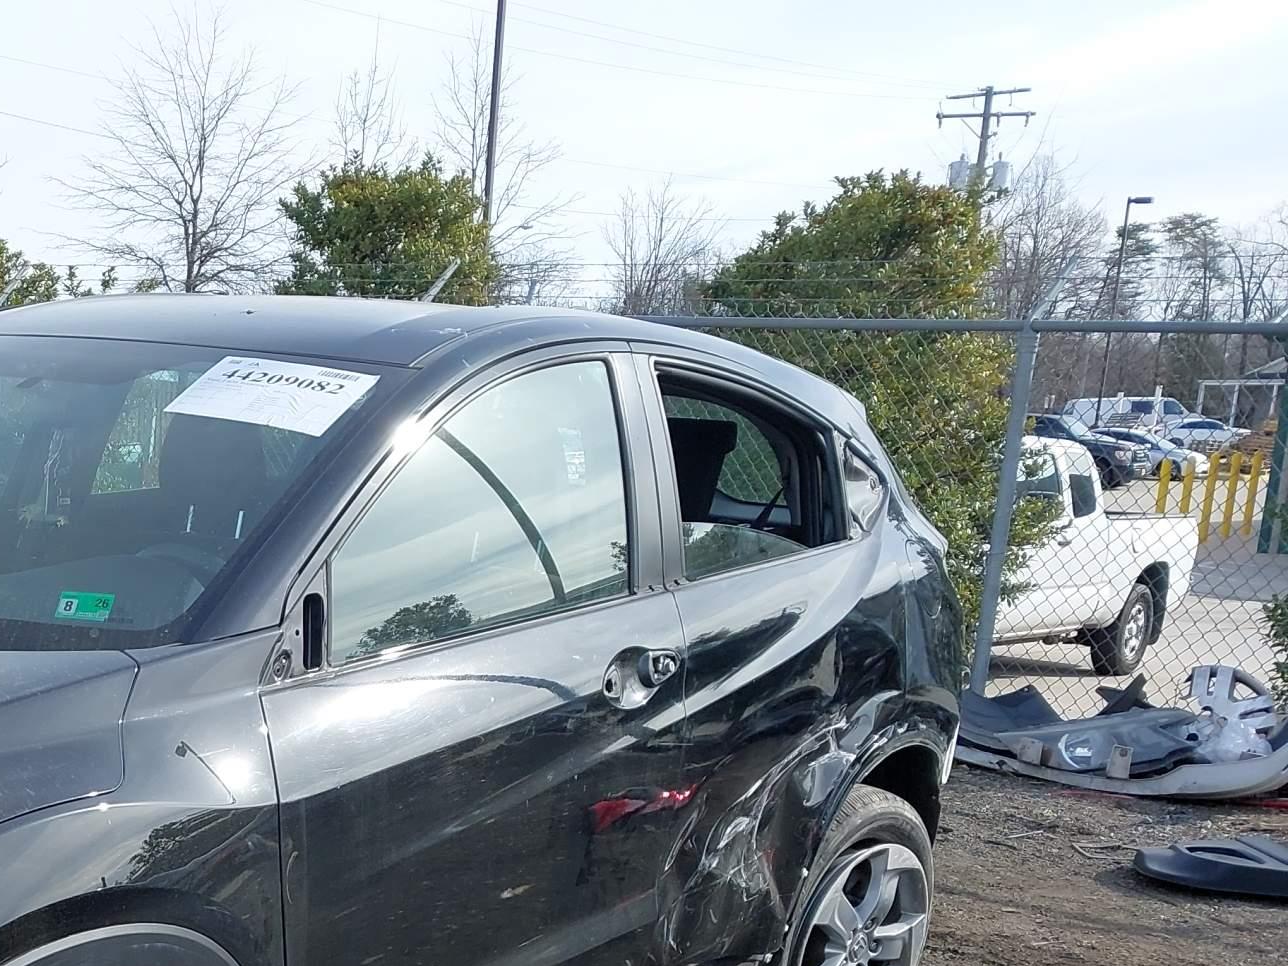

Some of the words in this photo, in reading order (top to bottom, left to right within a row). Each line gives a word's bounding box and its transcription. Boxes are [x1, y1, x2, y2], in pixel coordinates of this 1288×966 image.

[221, 367, 345, 396] 44209082
[64, 600, 74, 612] 8
[95, 598, 110, 609] 26
